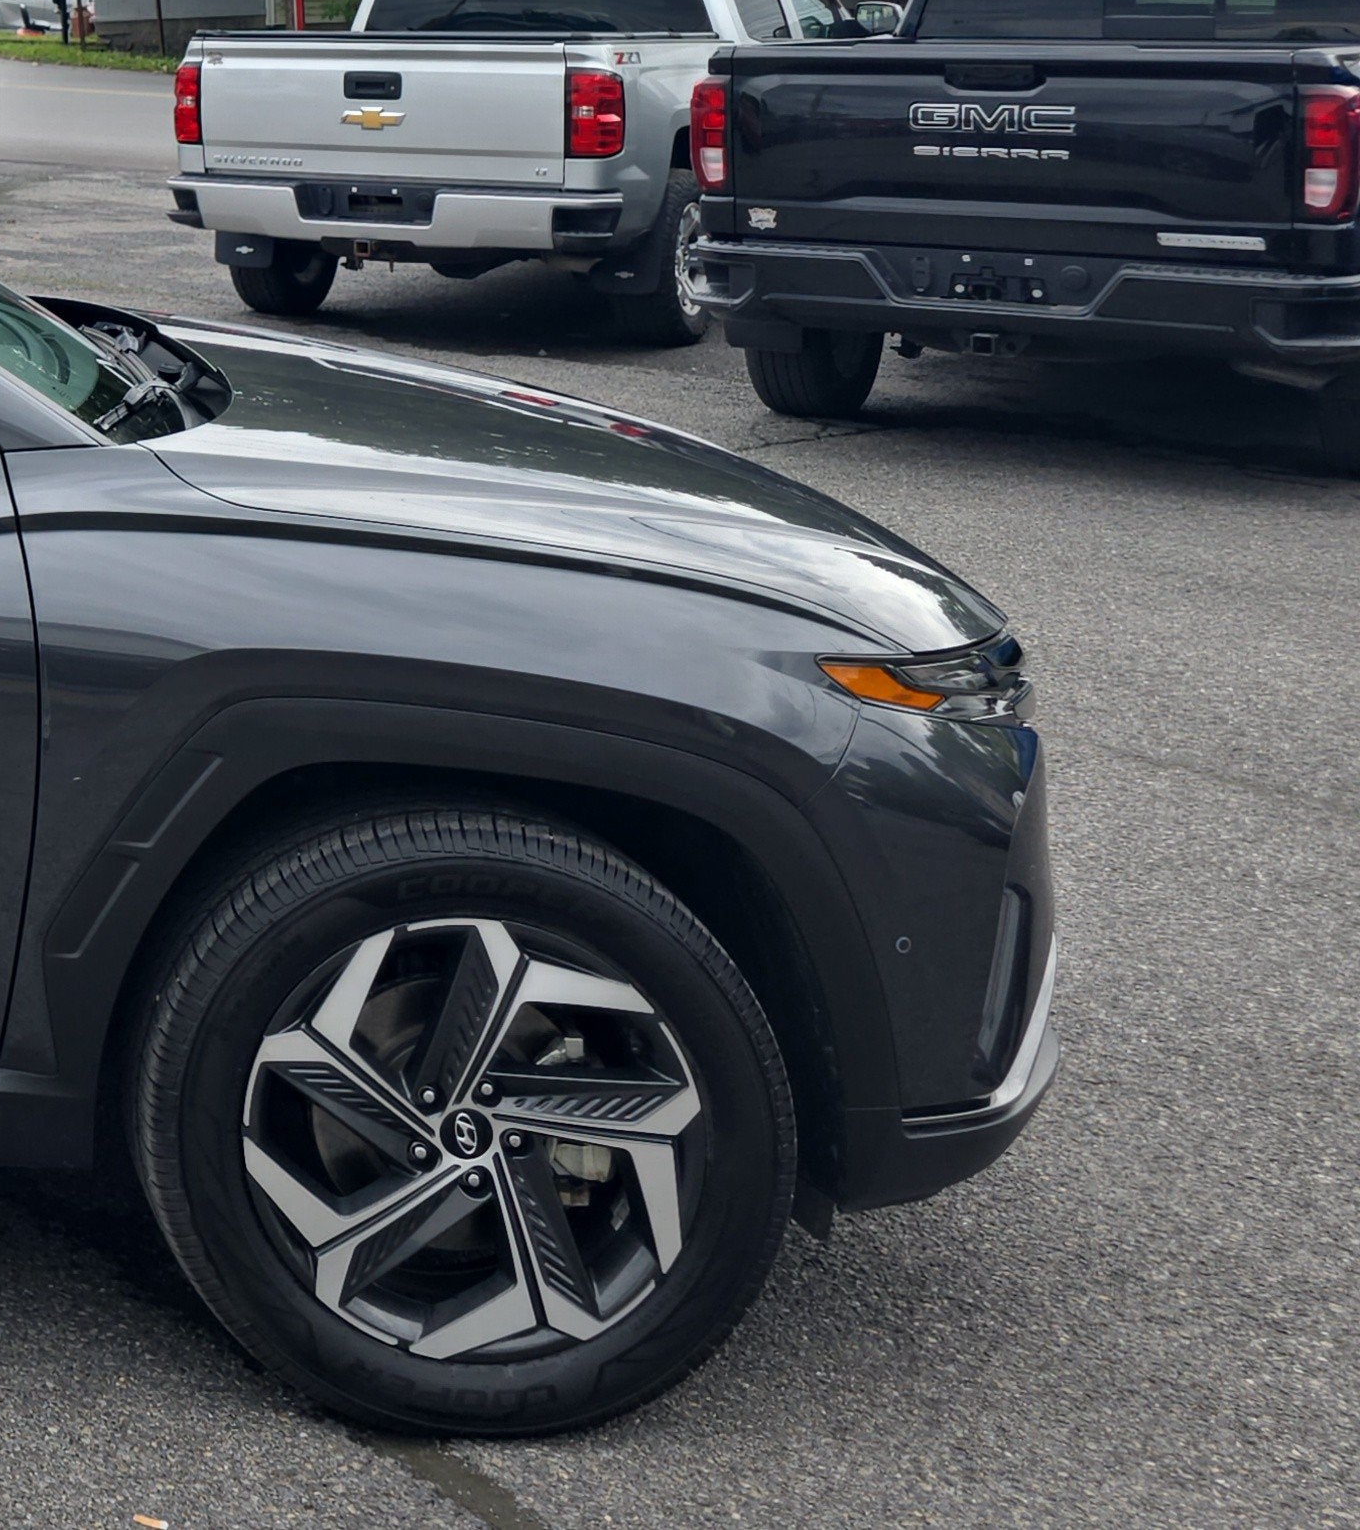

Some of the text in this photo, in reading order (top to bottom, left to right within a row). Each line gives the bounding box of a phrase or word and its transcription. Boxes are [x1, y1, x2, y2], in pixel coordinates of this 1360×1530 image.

[908, 102, 1077, 134] GMC
[912, 145, 1070, 160] SIERRA
[213, 154, 304, 167] SILVERADO
